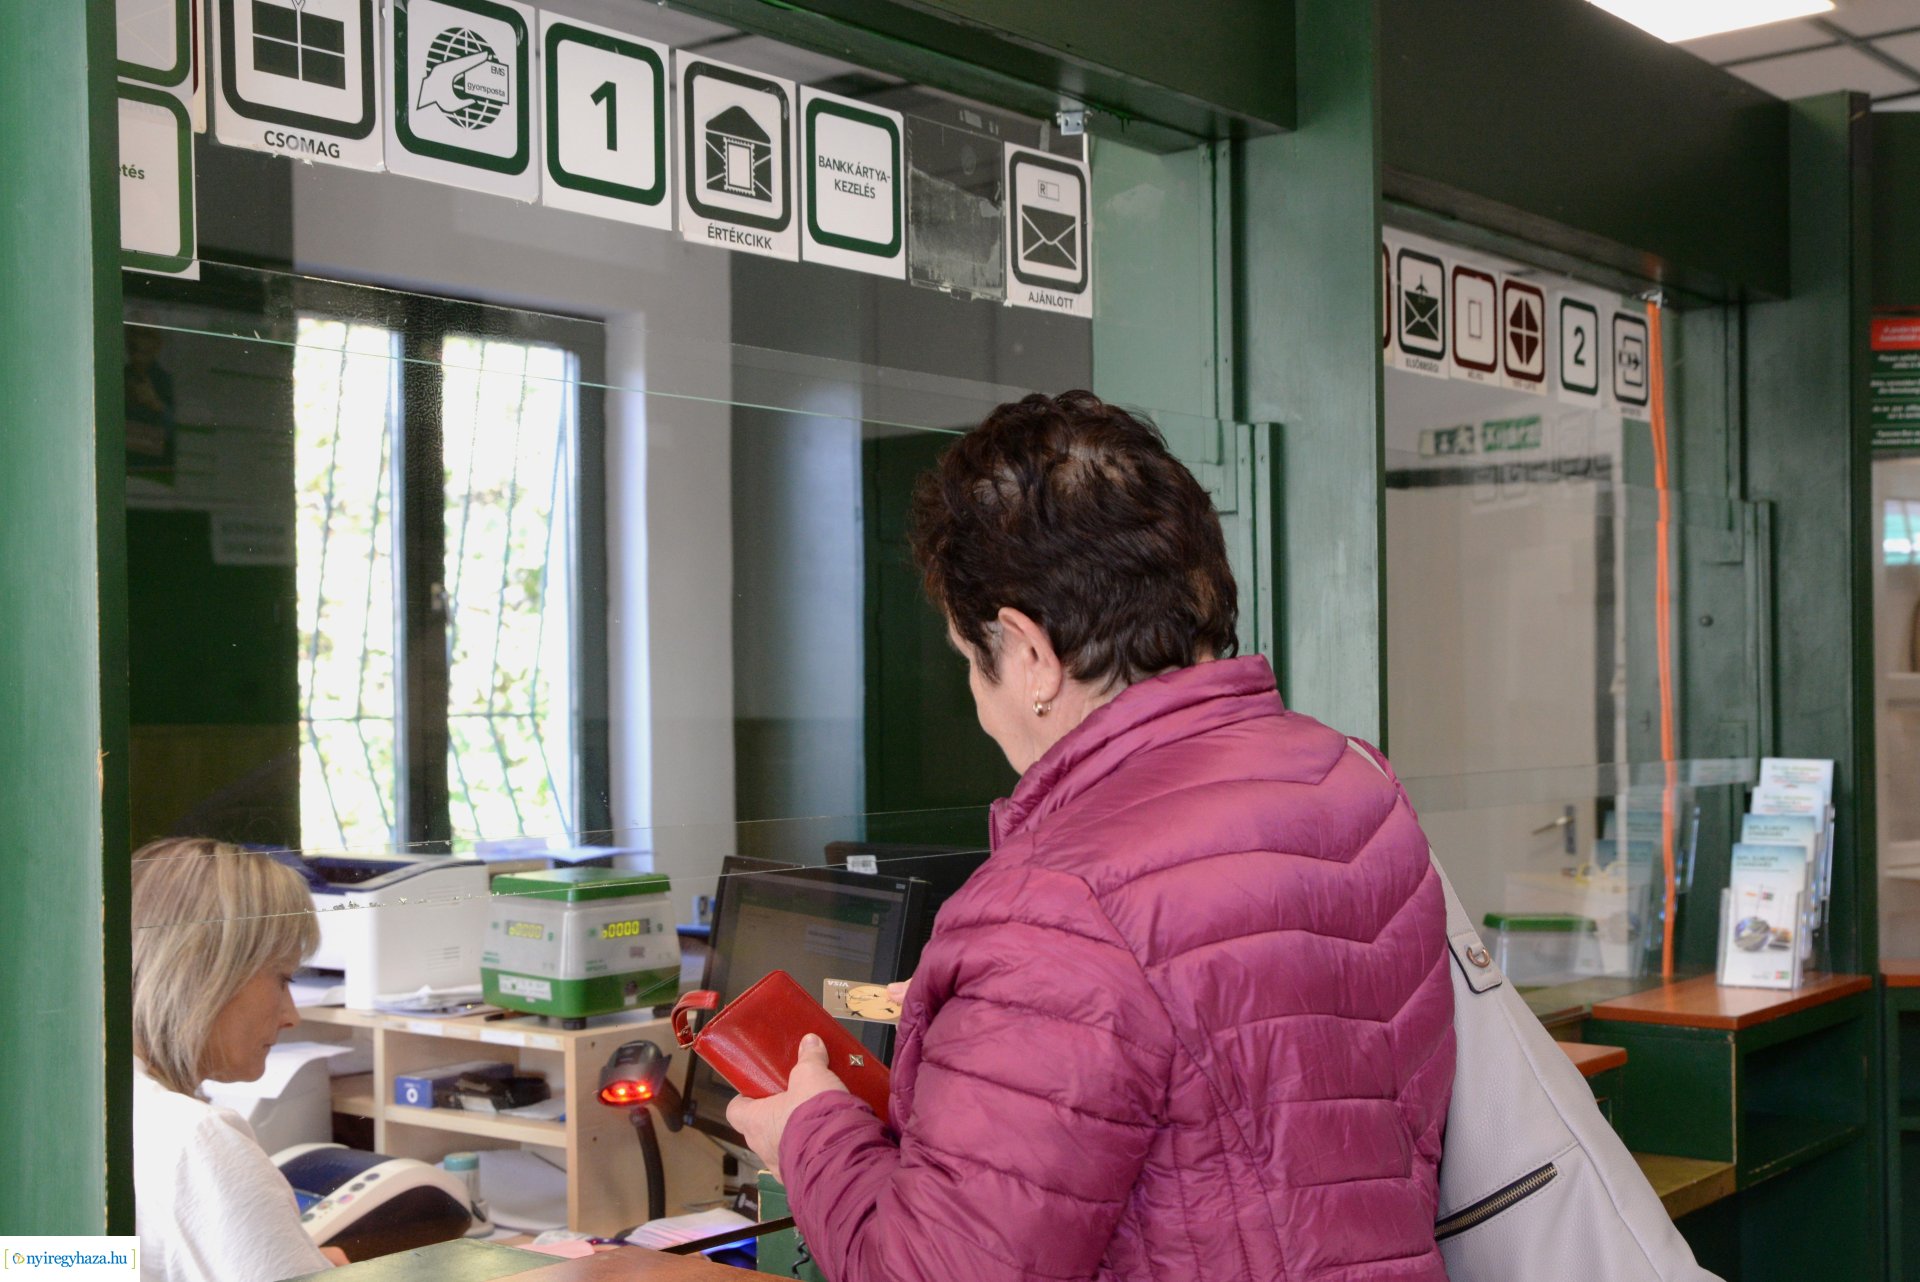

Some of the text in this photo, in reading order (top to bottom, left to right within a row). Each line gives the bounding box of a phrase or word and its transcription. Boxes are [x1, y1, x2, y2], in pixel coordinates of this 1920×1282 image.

[490, 65, 506, 77] EMS
[467, 82, 506, 97] gyorsposta
[590, 80, 619, 152] 1
[264, 130, 340, 158] CSOMAG
[818, 154, 891, 183] BANKKÁRTYA-
[834, 178, 876, 200] KEZELÉS
[707, 222, 773, 250] ÉRTÉKCIKK
[1028, 290, 1074, 309] AJÁNLOTT
[1573, 326, 1586, 367] 2
